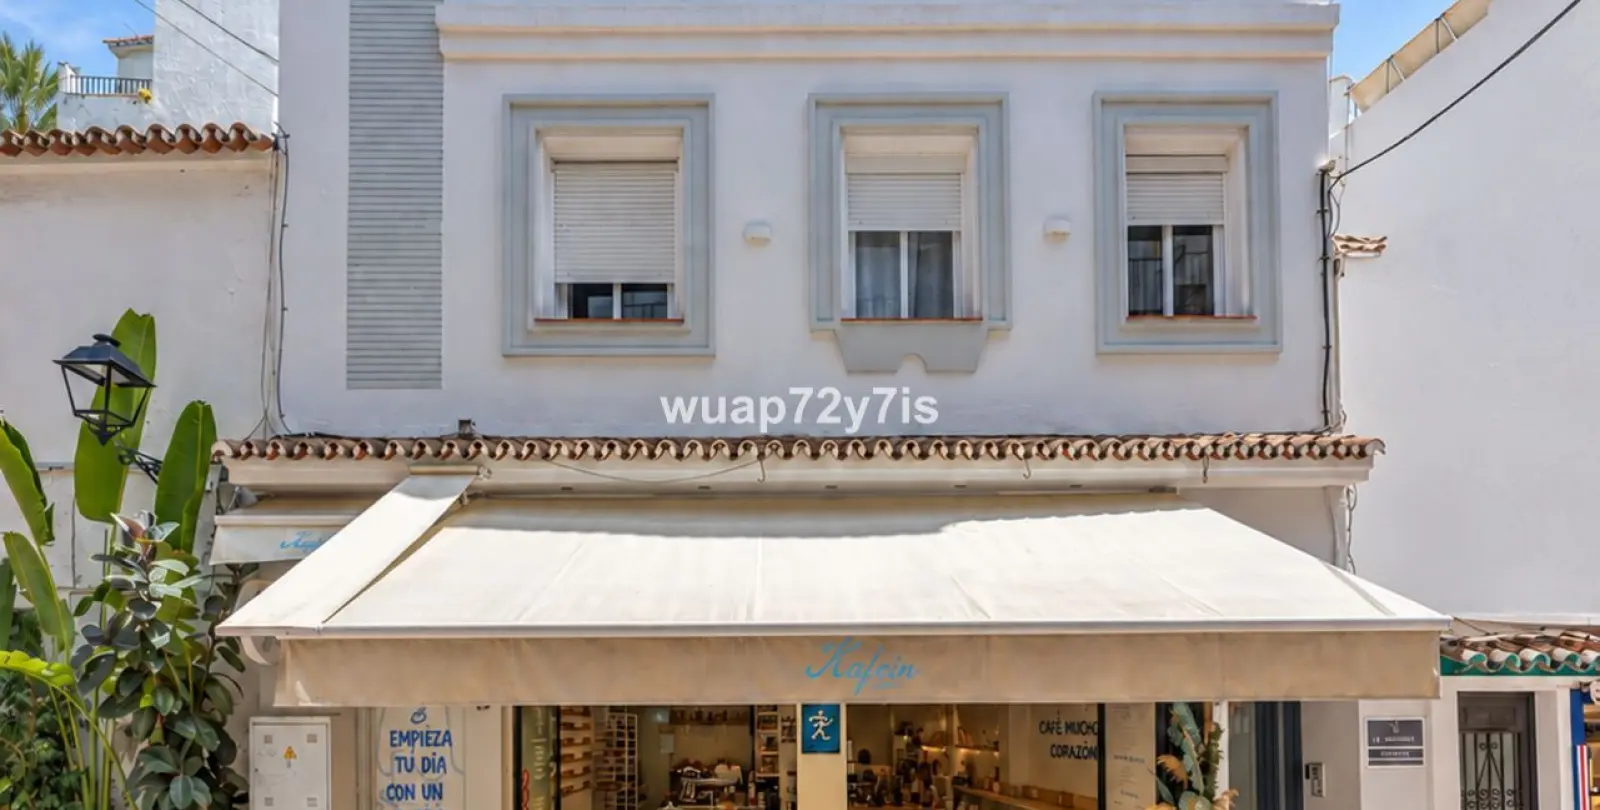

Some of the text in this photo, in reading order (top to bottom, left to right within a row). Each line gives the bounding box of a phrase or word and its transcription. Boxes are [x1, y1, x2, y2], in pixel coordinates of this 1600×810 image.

[390, 729, 452, 749] EMPIEZA
[386, 782, 443, 801] CON UN
